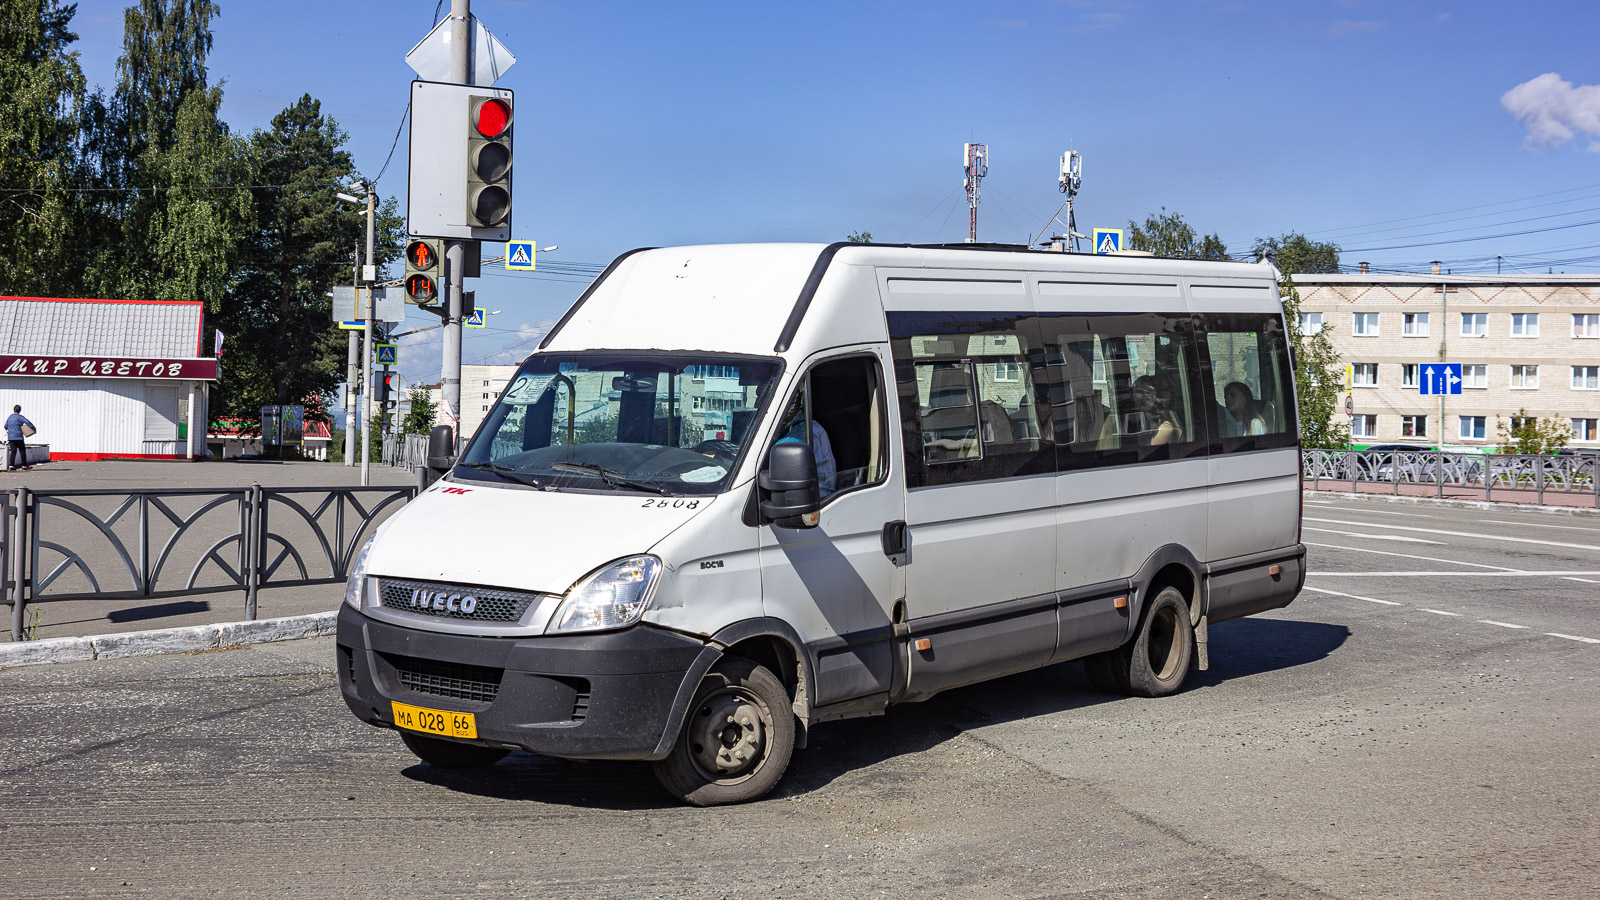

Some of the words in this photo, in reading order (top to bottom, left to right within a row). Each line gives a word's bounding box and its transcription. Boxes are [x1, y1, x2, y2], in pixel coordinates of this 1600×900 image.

[412, 279, 431, 297] 14
[4, 358, 68, 374] МИР
[80, 360, 183, 376] ЦВЕТОВ
[506, 377, 528, 398] 2
[641, 498, 700, 510] 2808
[410, 589, 477, 613] IVECO
[418, 711, 445, 731] 028
[453, 715, 469, 730] 66
